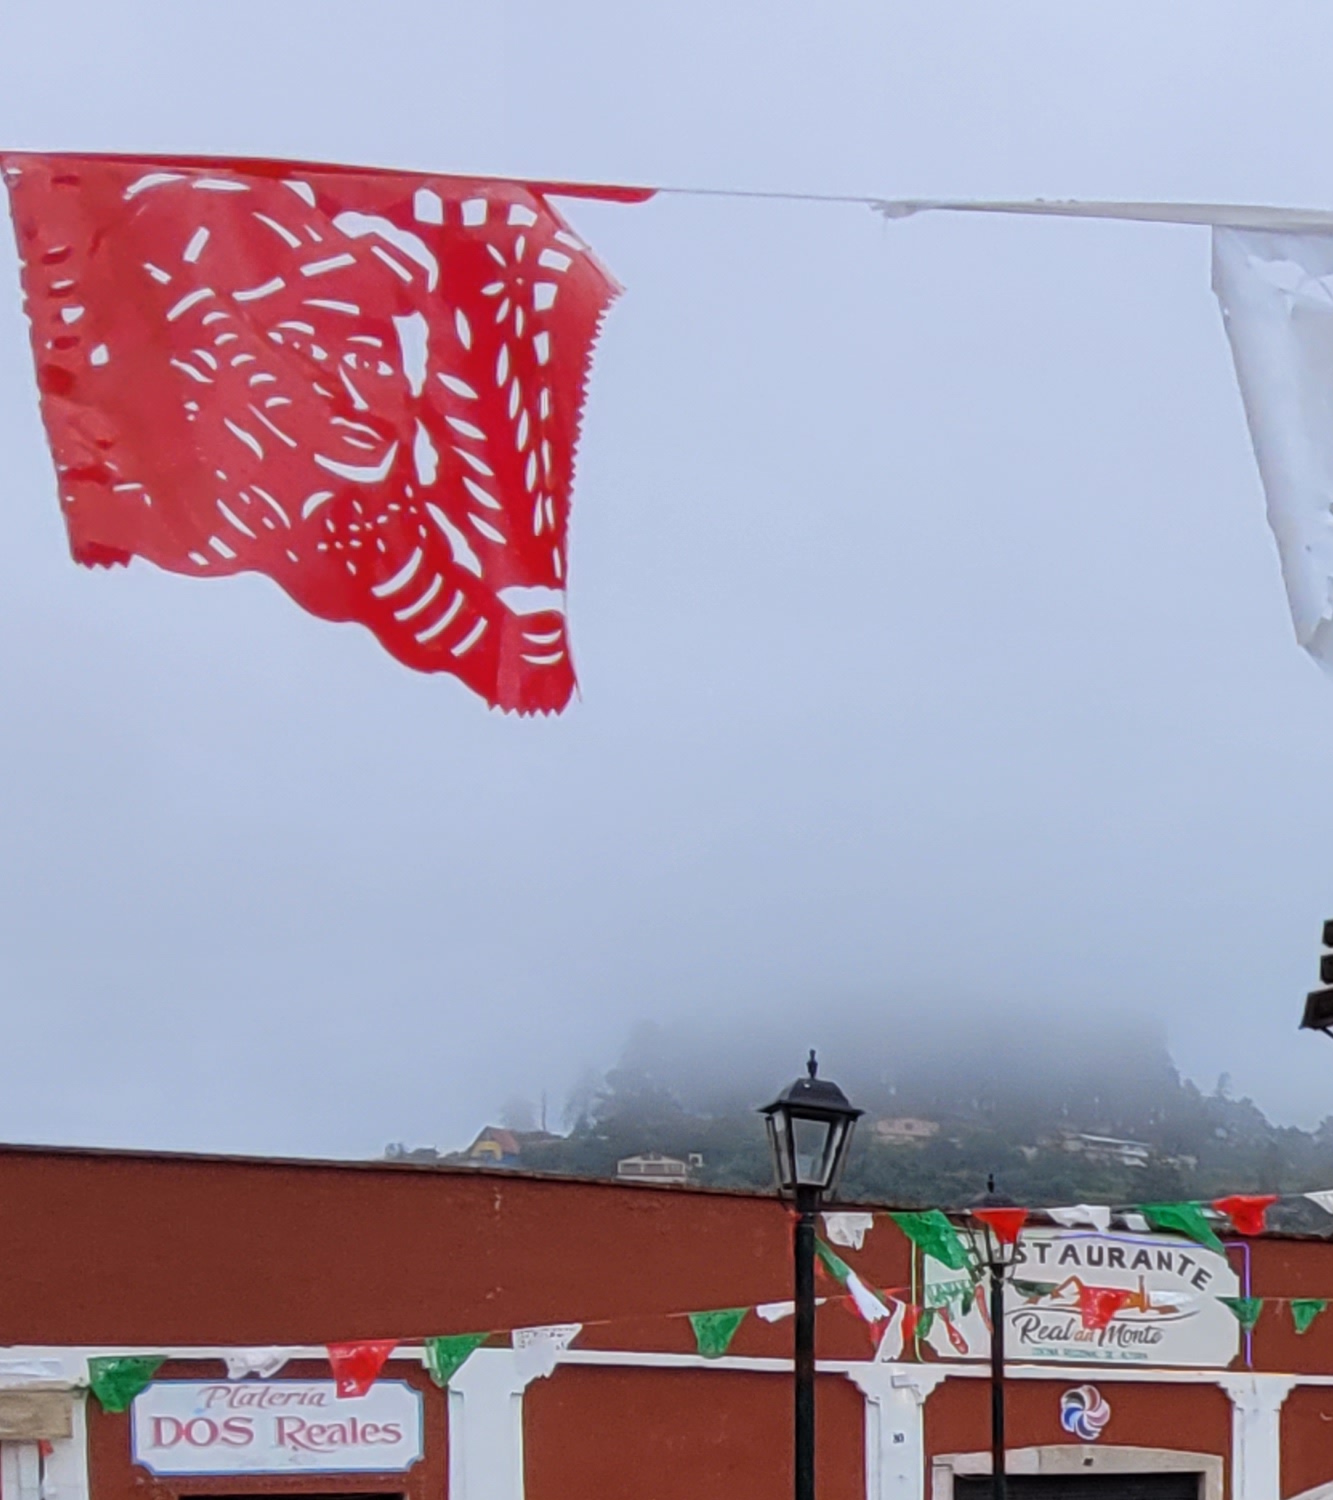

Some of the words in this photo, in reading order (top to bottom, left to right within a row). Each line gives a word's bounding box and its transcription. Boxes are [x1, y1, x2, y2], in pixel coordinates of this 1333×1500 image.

[1013, 1241, 1213, 1292] STAURANTE
[1011, 1312, 1076, 1344] Real
[1096, 1323, 1164, 1349] Monte
[150, 1416, 255, 1448] DOS
[275, 1416, 403, 1453] Reales
